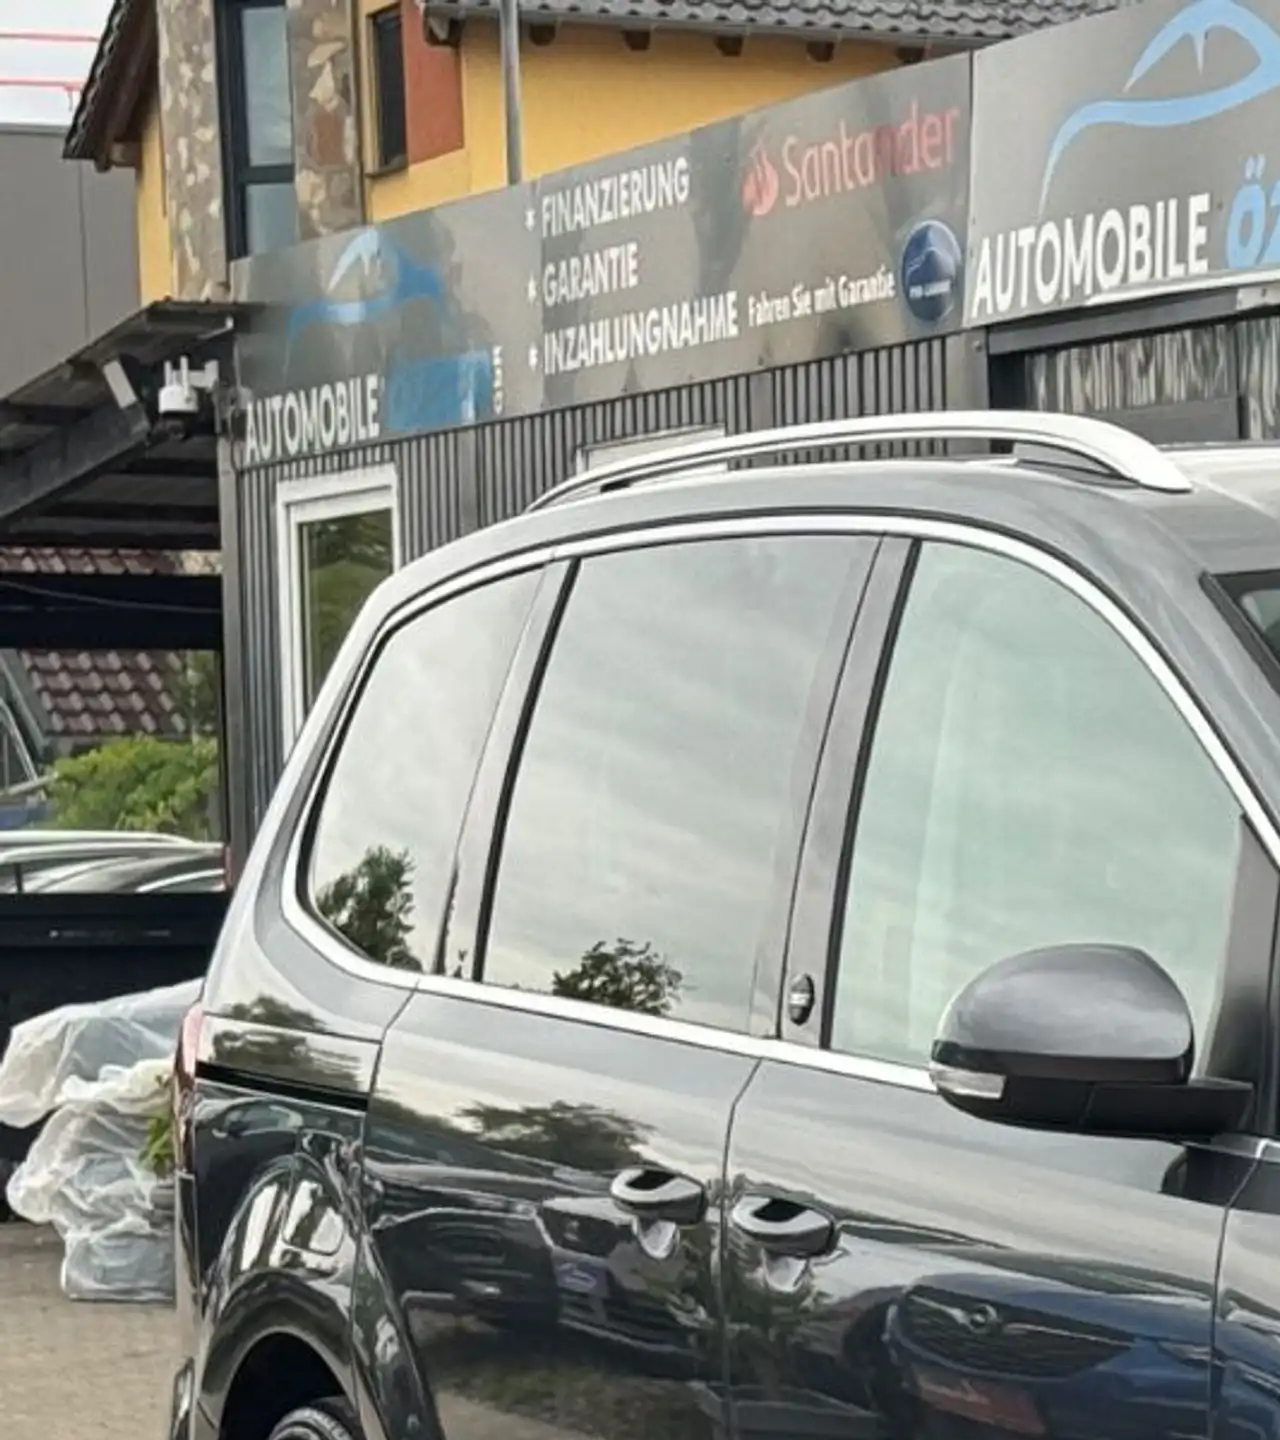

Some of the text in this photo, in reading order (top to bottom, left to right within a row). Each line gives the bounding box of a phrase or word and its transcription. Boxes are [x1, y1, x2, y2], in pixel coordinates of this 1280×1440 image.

[541, 156, 690, 238] FINANZIERUNG
[782, 101, 961, 209] Santander
[543, 242, 639, 308] GARANTIE
[748, 291, 791, 328] Fahren
[792, 283, 813, 319] Sie
[814, 277, 837, 311] mit
[838, 263, 896, 309] Garantie
[971, 193, 1211, 319] AUTOMOBILE
[544, 290, 738, 376] INZAHLUNGNAHME
[245, 374, 380, 465] AUTOMOBILE
